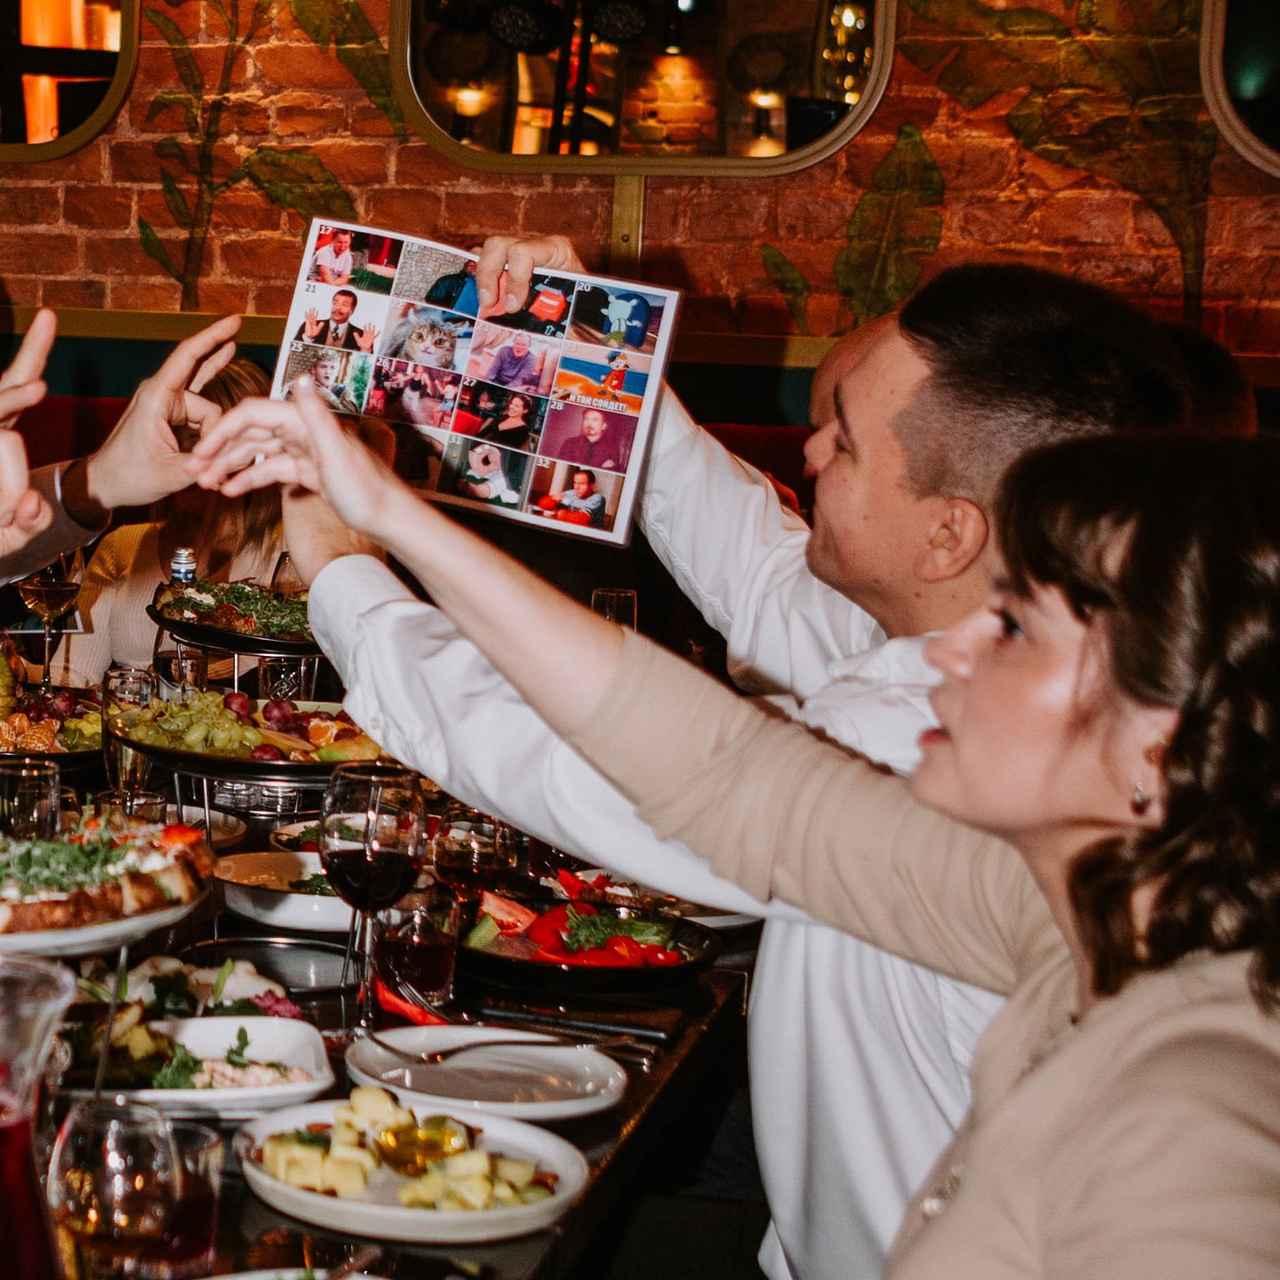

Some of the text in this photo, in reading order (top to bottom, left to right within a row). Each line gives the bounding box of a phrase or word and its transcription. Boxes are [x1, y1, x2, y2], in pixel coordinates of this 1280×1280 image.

[320, 225, 333, 235] 17
[406, 242, 419, 252] 18
[305, 284, 316, 293] 21
[578, 281, 591, 292] 20
[291, 343, 303, 352] 25
[376, 358, 389, 367] 26
[463, 377, 477, 387] 27
[550, 401, 563, 411] 28
[449, 435, 461, 445] 31
[536, 458, 550, 468] 32
